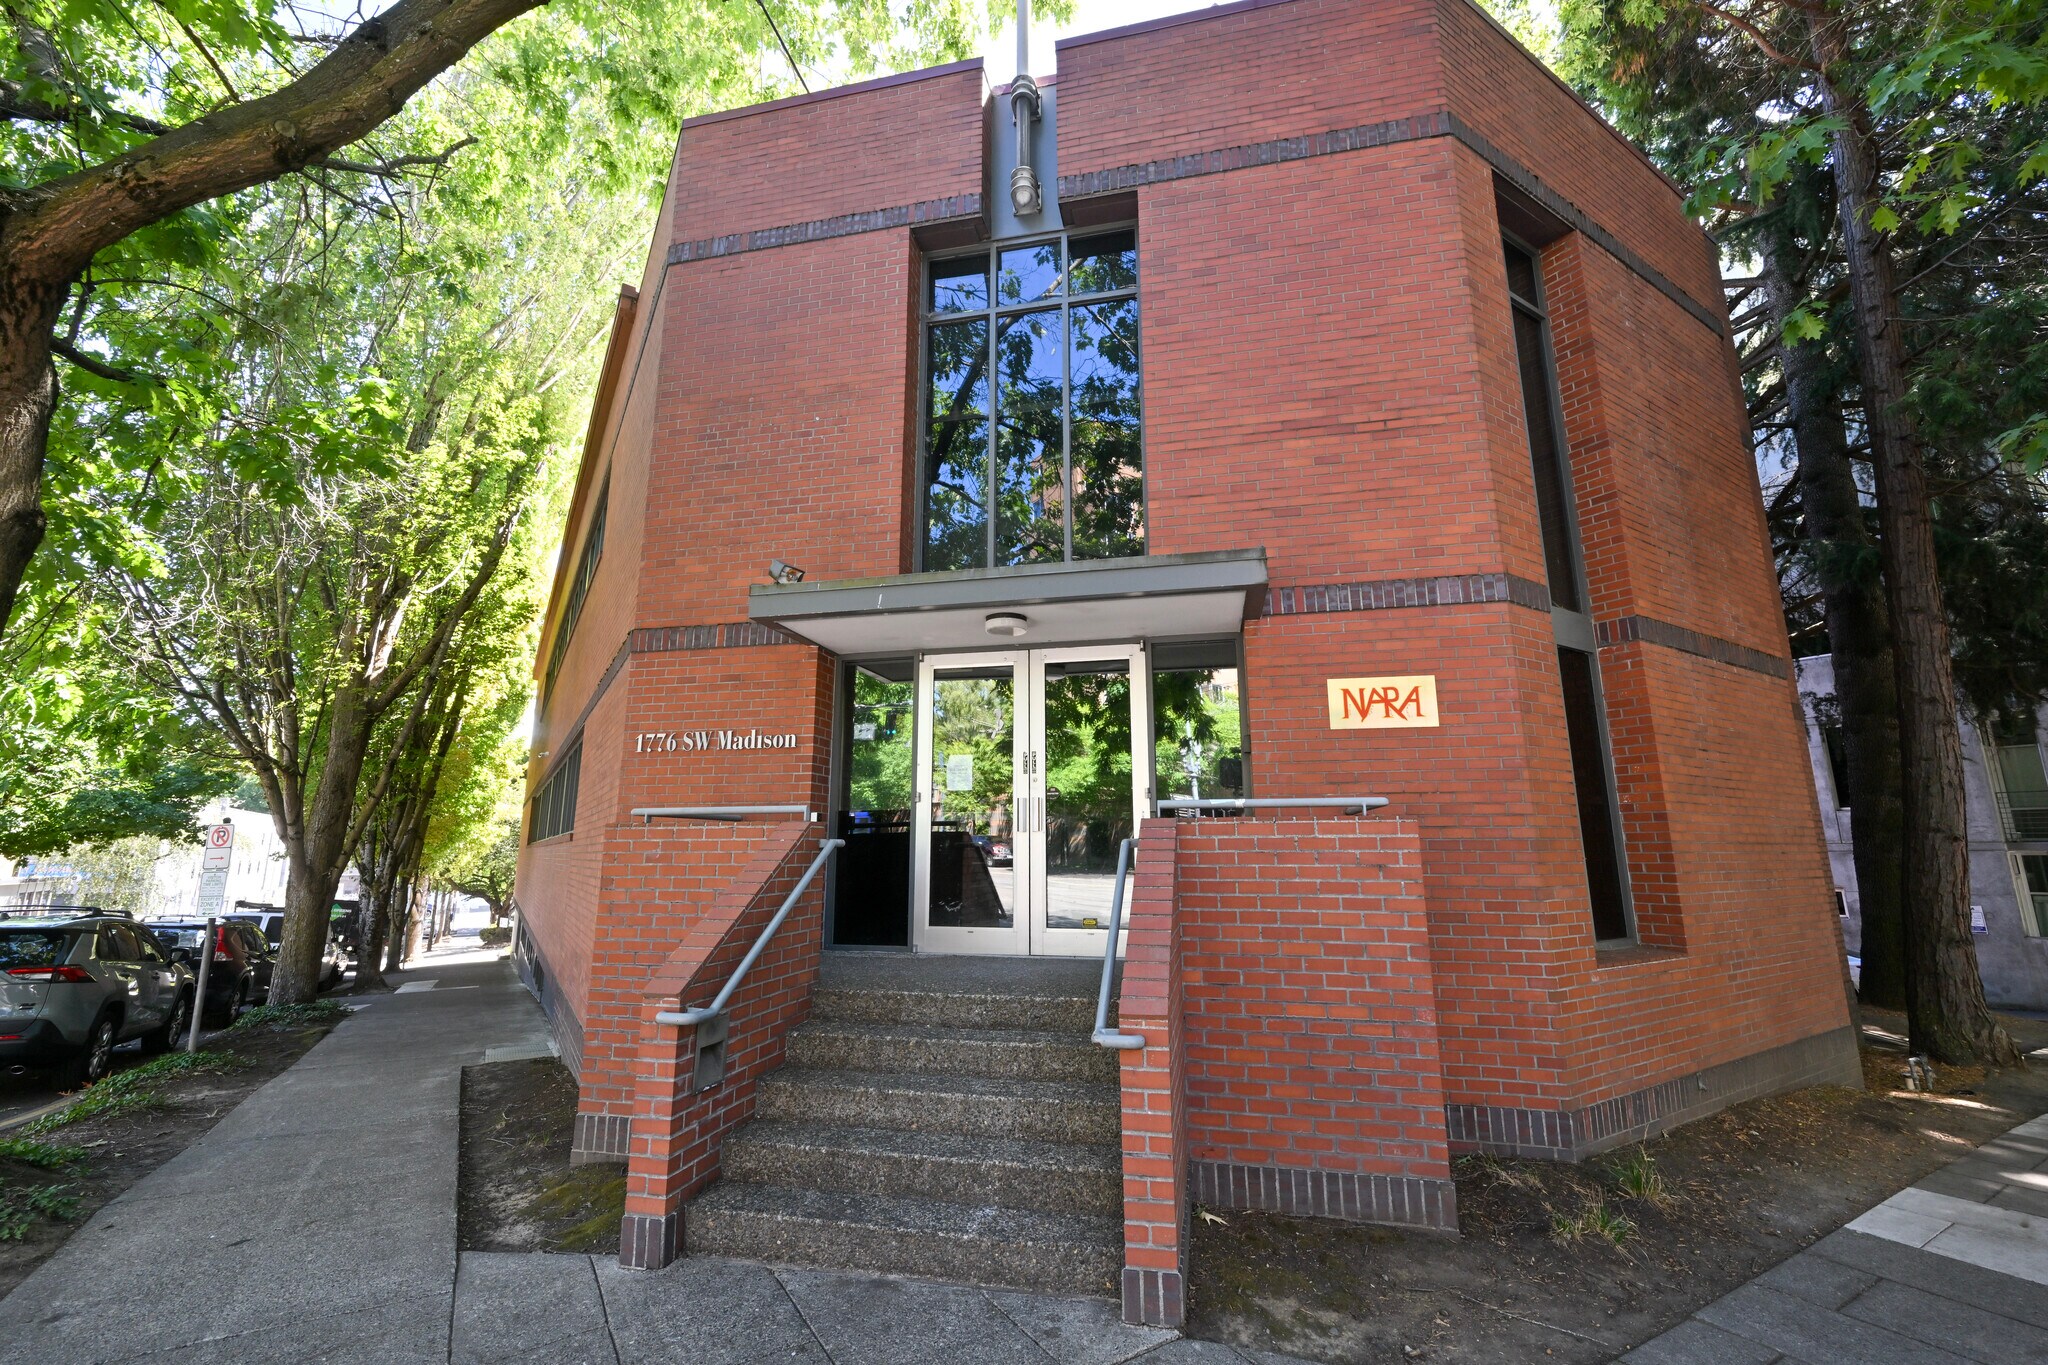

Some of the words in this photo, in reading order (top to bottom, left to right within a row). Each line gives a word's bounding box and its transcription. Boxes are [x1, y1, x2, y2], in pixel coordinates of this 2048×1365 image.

[1340, 685, 1426, 722] NARA
[635, 733, 677, 753] 1776
[682, 730, 714, 751] SW
[717, 729, 797, 750] Madison
